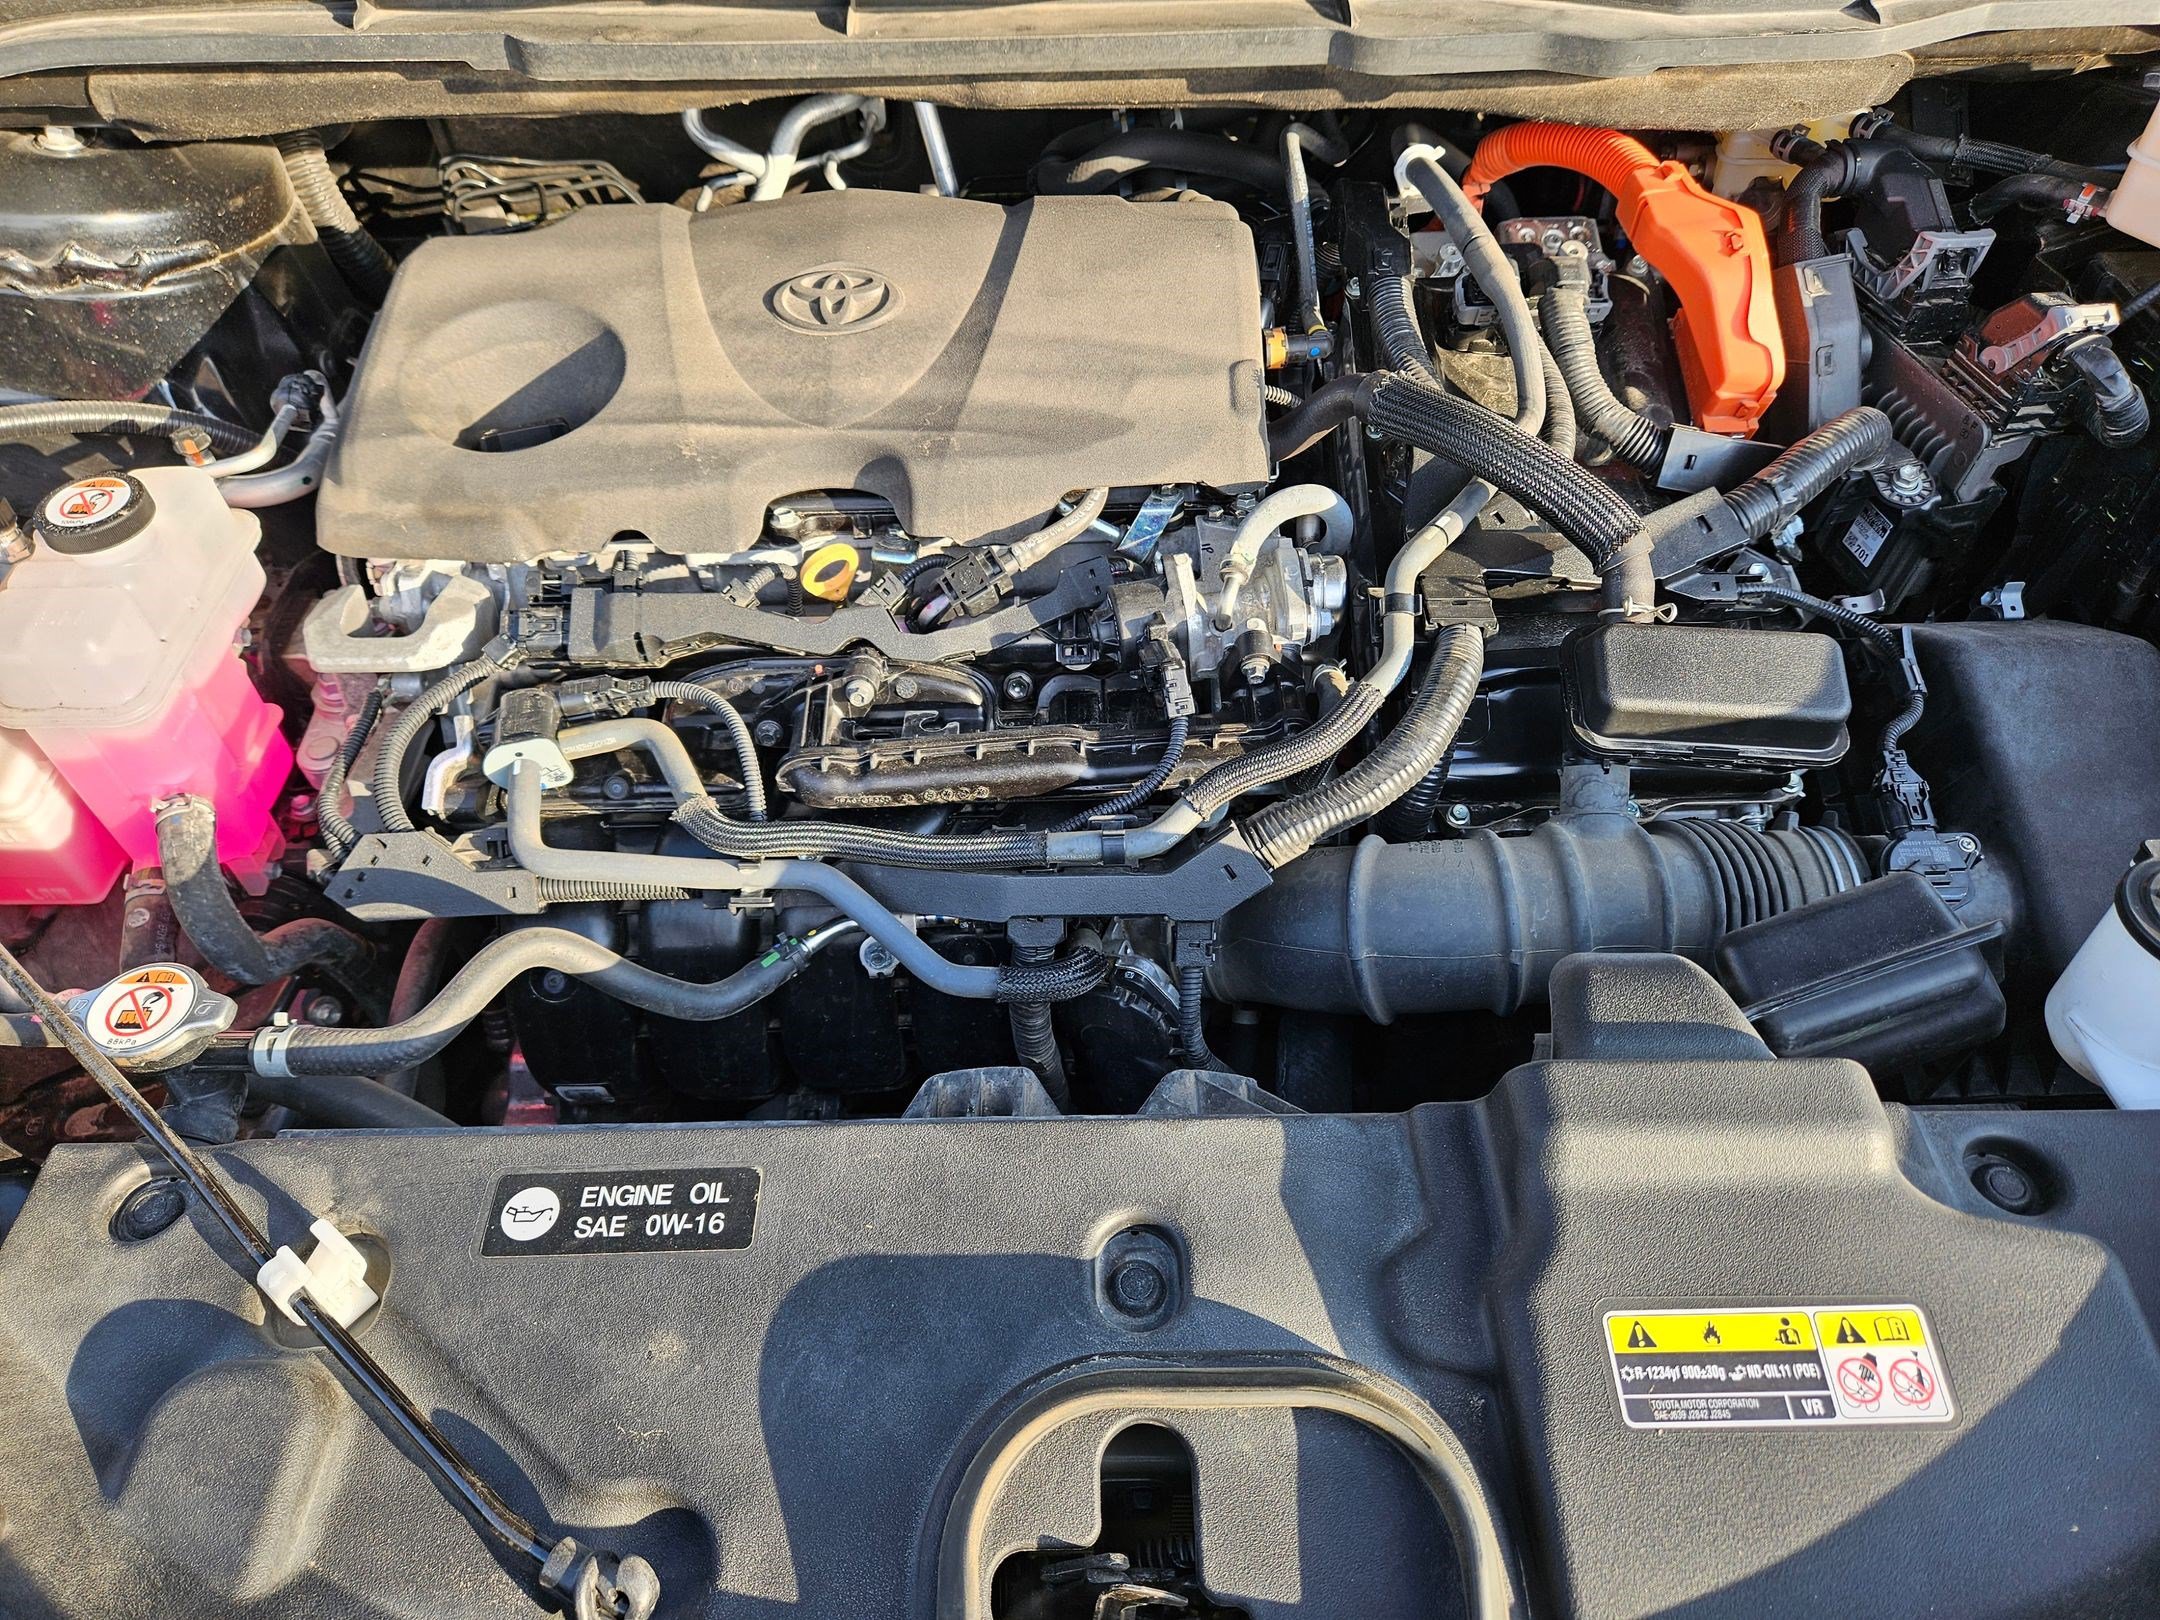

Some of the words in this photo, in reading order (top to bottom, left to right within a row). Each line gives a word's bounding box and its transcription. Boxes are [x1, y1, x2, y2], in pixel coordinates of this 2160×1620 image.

[1853, 545, 1870, 563] 701
[580, 1183, 674, 1208] ENGINE
[689, 1182, 730, 1205] OIL
[574, 1215, 627, 1239] SAE
[645, 1212, 726, 1236] 0W-16
[1634, 1365, 1680, 1382] R-1234yf
[1746, 1363, 1792, 1379] ND-OIL11
[1792, 1363, 1821, 1380] (POE)
[1651, 1399, 1679, 1410] TOYOTA
[1680, 1399, 1707, 1409] MOTOR
[1708, 1398, 1760, 1409] CORPORATION
[1801, 1398, 1825, 1416] VR
